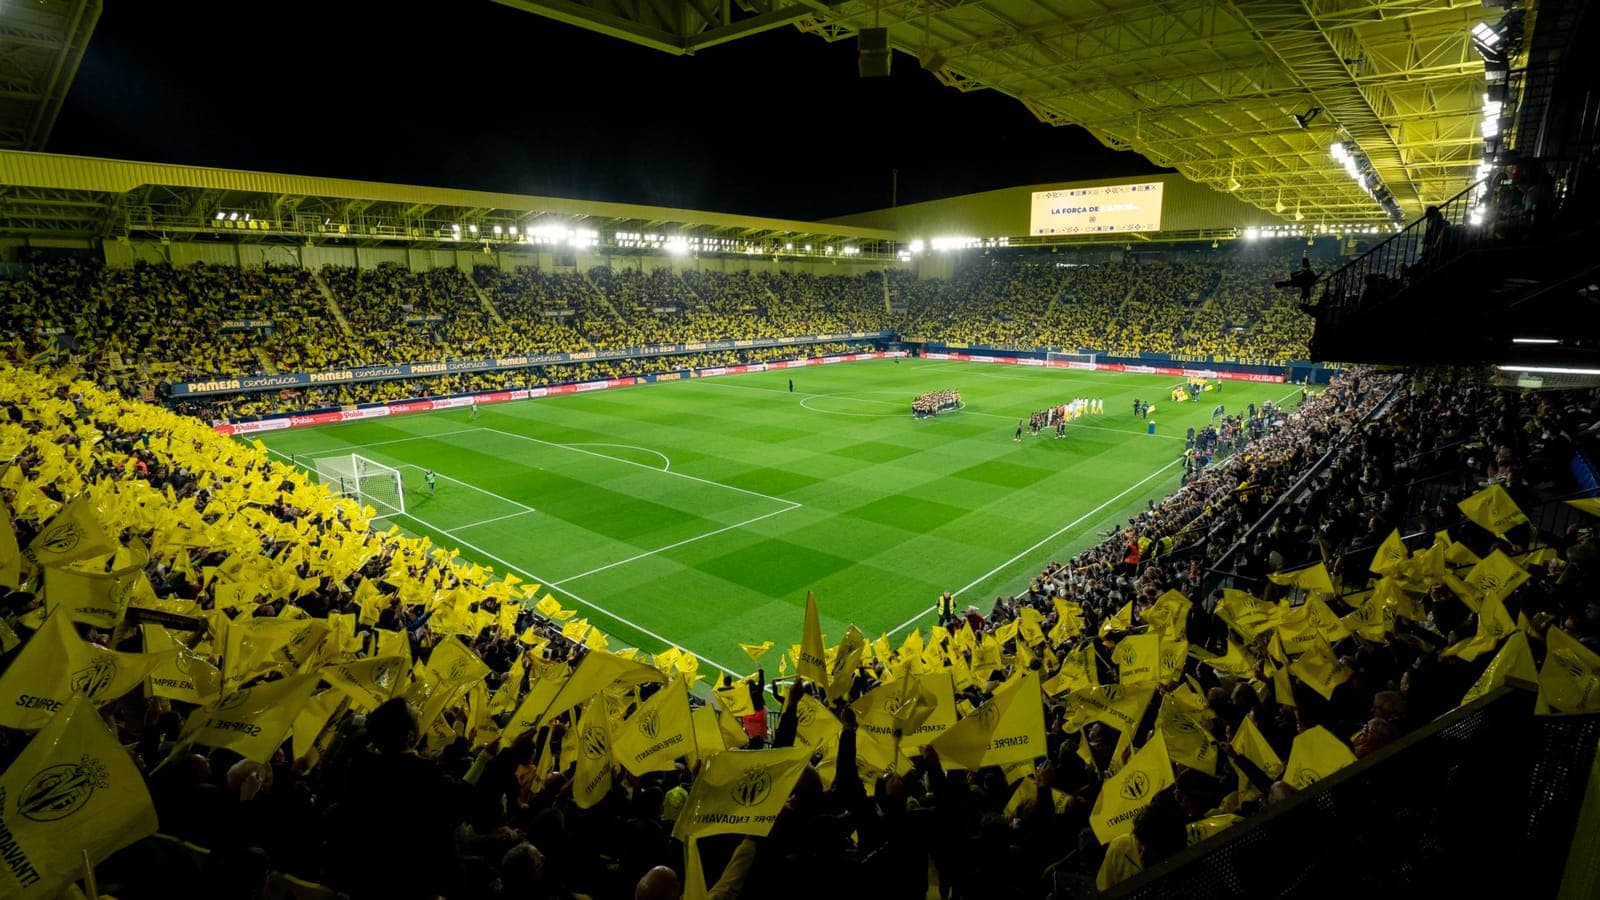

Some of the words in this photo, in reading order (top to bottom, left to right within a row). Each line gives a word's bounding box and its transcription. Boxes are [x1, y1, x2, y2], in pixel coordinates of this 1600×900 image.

[1062, 207, 1087, 215] FORÇA
[411, 363, 448, 374] PAMESA
[310, 371, 353, 382] PAMESA
[188, 380, 240, 393] PAMESA
